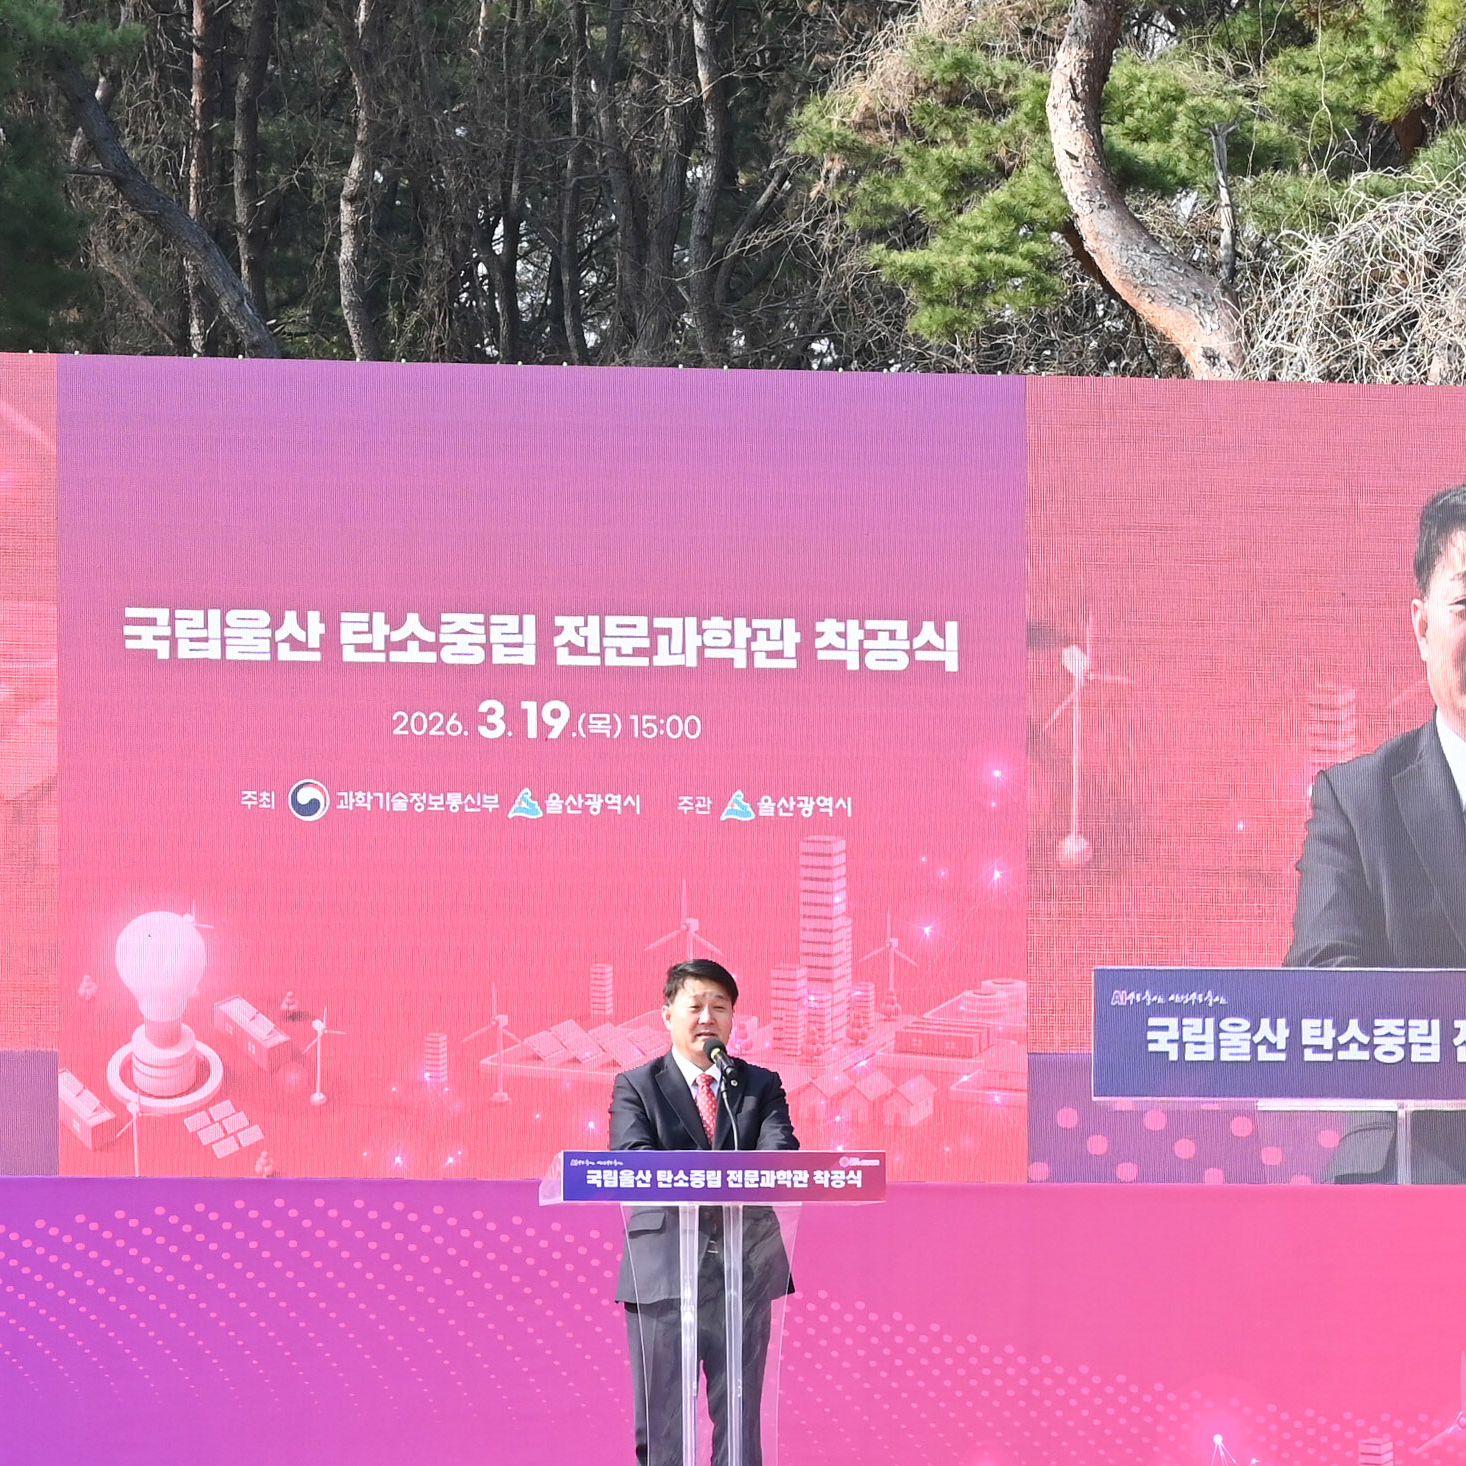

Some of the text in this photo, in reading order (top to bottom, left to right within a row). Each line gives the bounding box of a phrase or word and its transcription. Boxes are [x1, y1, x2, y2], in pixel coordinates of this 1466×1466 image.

[123, 606, 960, 674] 국립울산 탄소중립 전문과학관 착공식
[392, 710, 469, 737] 2026.
[629, 714, 703, 740] 15:00
[240, 789, 500, 813] 주최 과학기술정보통신부
[545, 792, 641, 815] 울산광역시
[677, 794, 853, 818] 주관 울산광역시
[1145, 1016, 1291, 1063] 국립울산
[1300, 1017, 1441, 1064] 탄소중립
[586, 1168, 863, 1189] 국립울산 탄소중립 전문과학관 착공식
